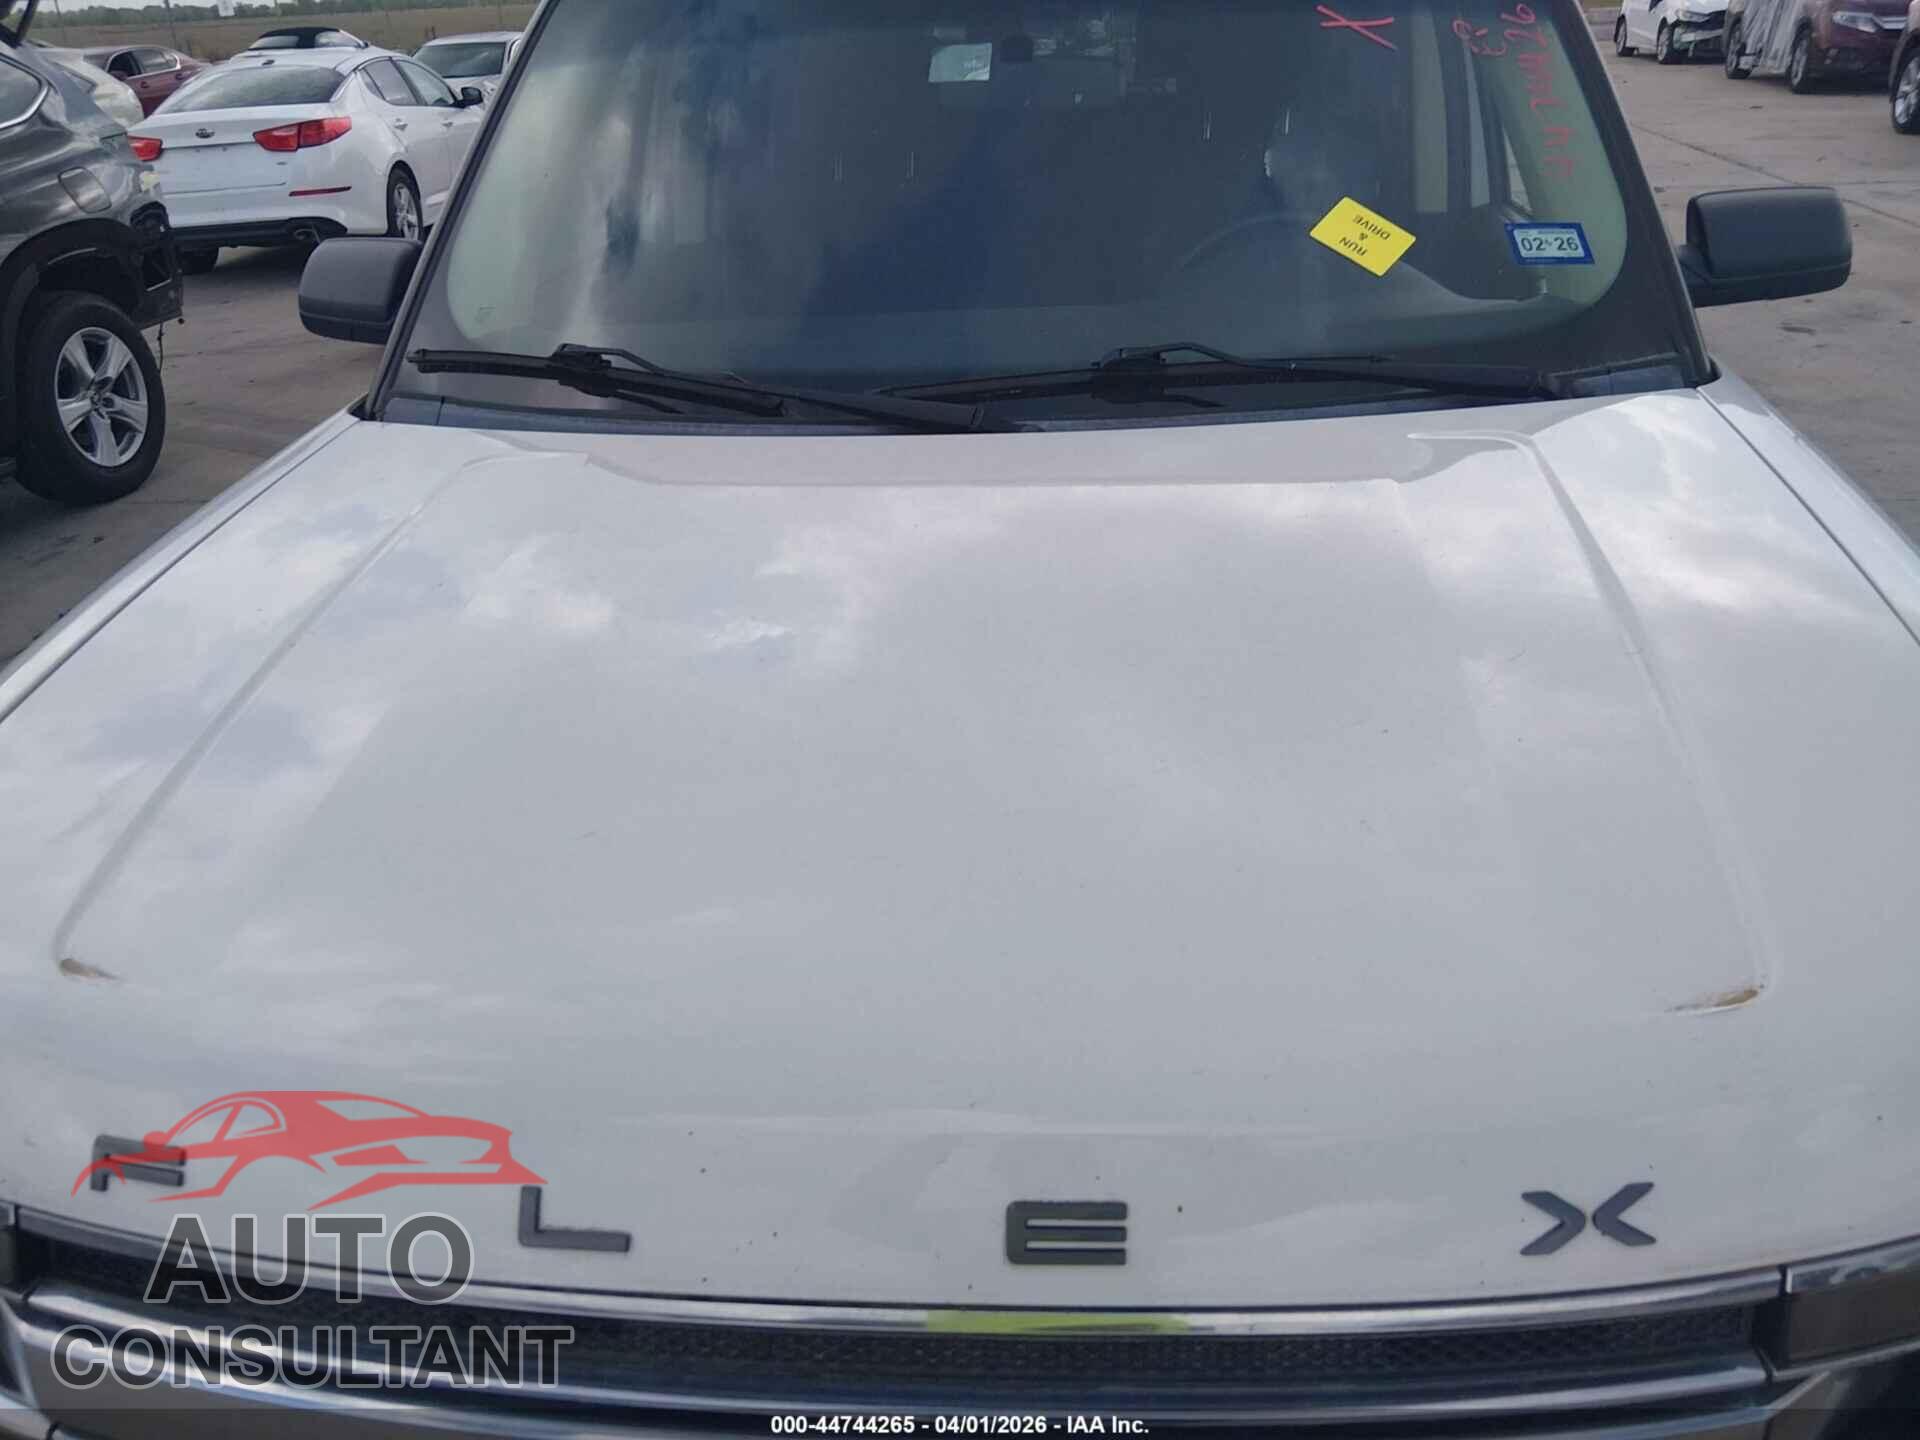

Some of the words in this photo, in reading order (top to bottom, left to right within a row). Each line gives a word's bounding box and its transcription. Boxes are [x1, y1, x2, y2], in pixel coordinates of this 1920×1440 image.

[1352, 214, 1391, 240] DRIVE
[1339, 236, 1368, 256] RUN
[1520, 237, 1546, 251] 02
[1553, 236, 1579, 251] 26
